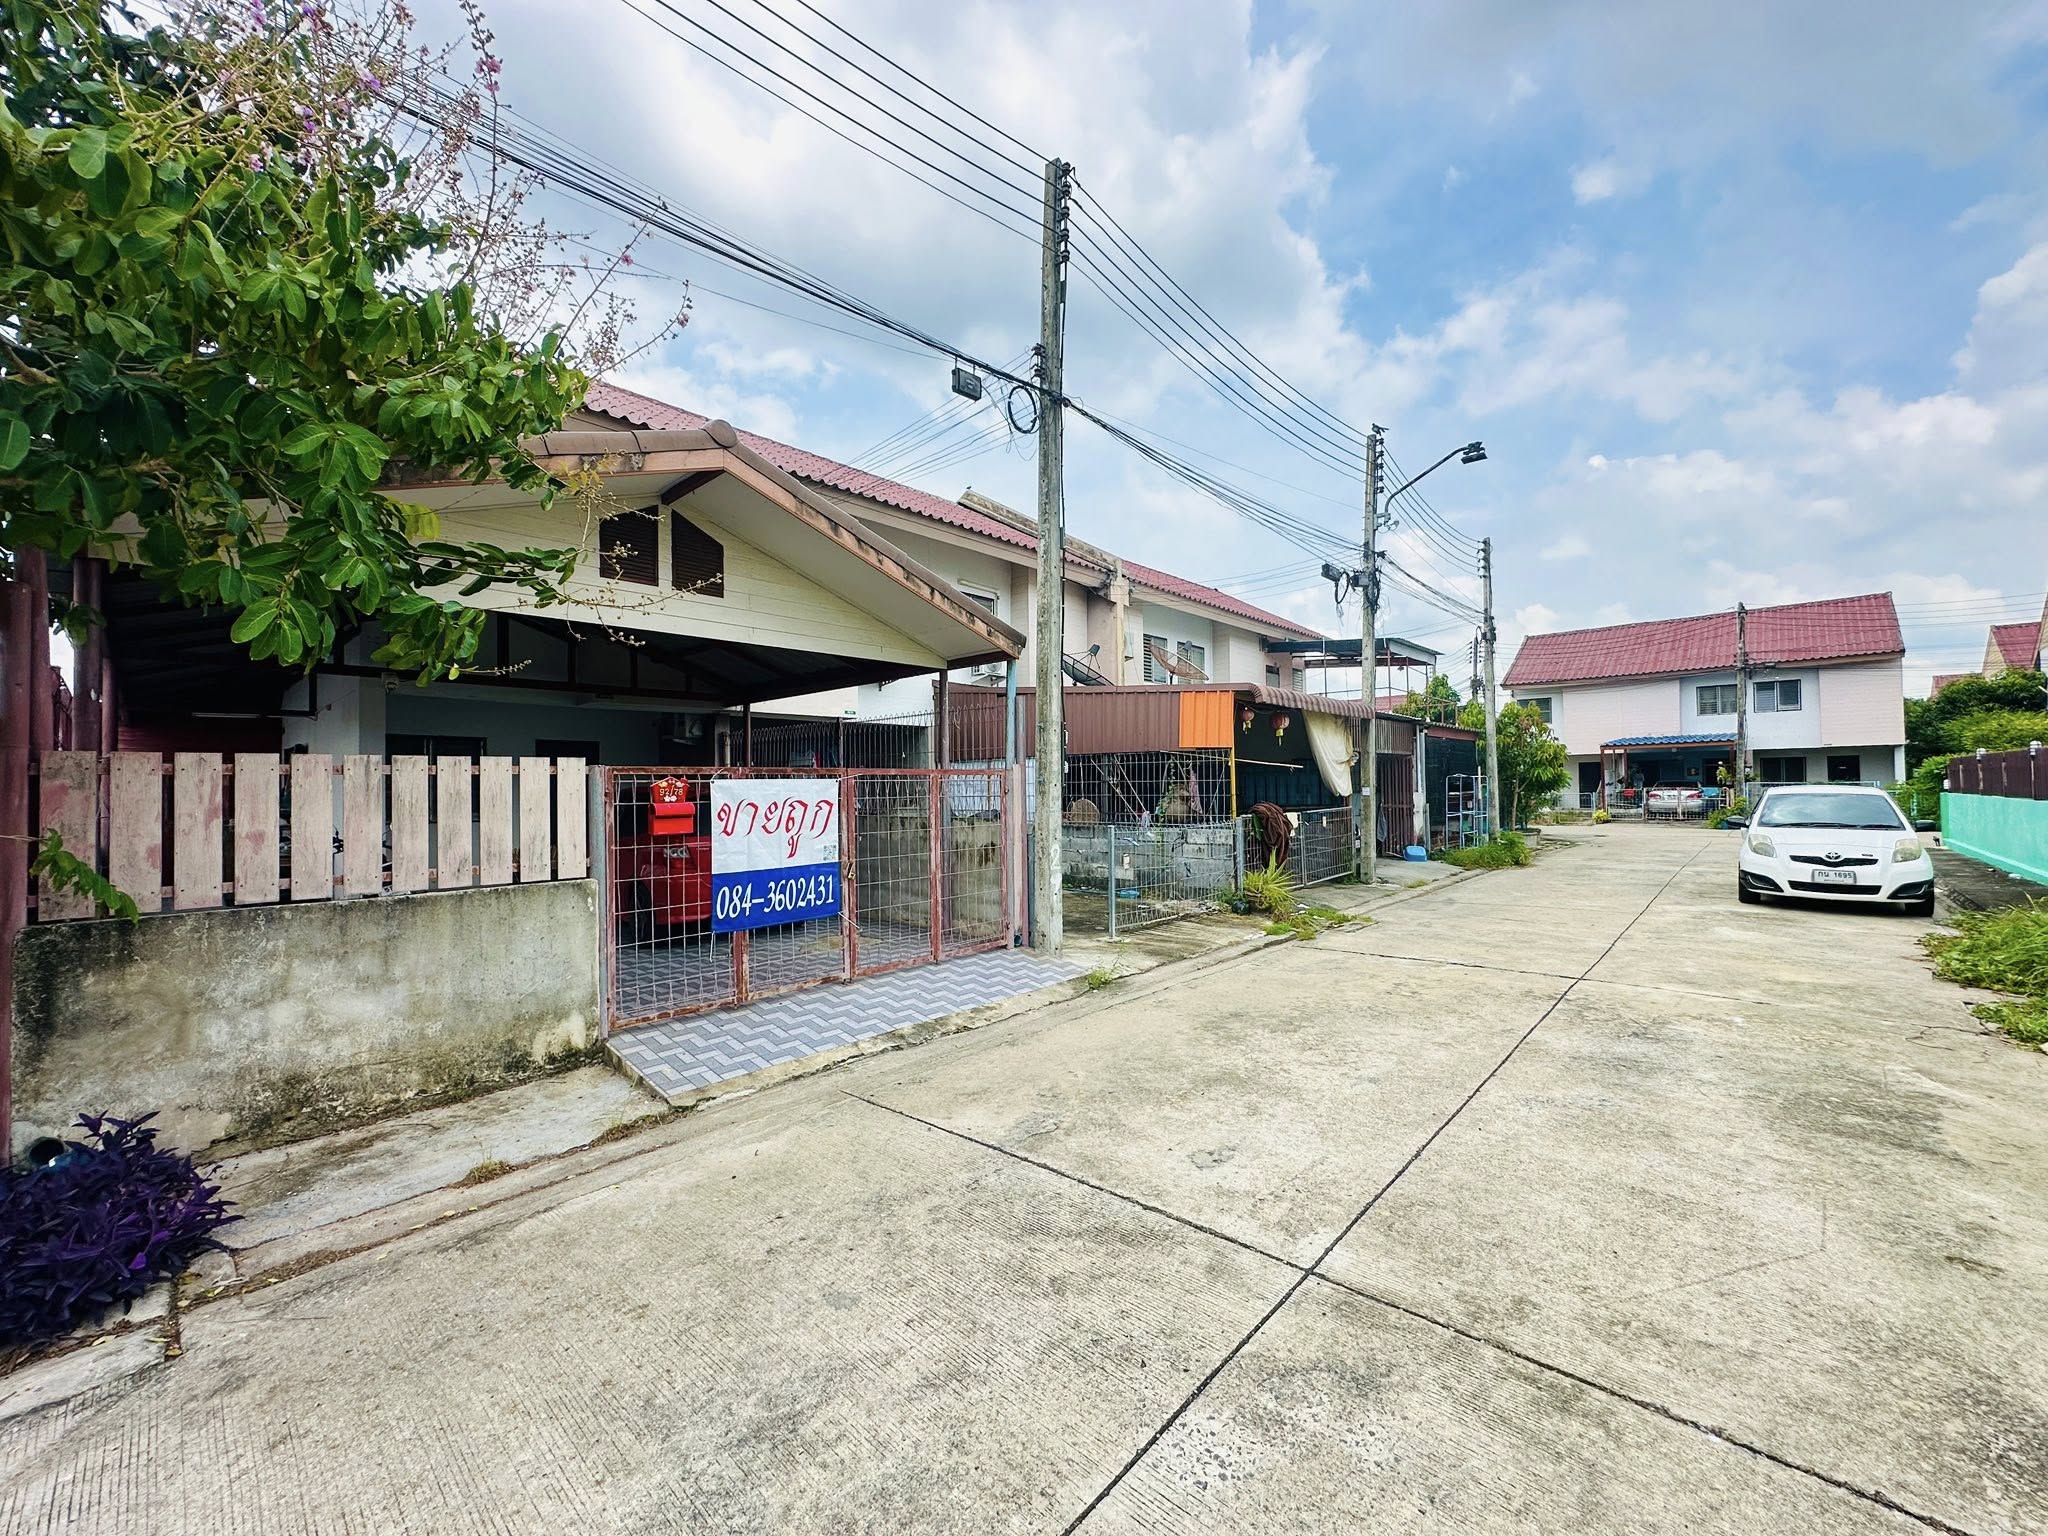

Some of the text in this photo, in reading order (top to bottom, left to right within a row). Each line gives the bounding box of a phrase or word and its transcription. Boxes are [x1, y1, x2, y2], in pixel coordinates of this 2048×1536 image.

[659, 785, 684, 796] 92/78
[716, 796, 834, 859] ขายถูก
[716, 874, 834, 920] 084-3602431
